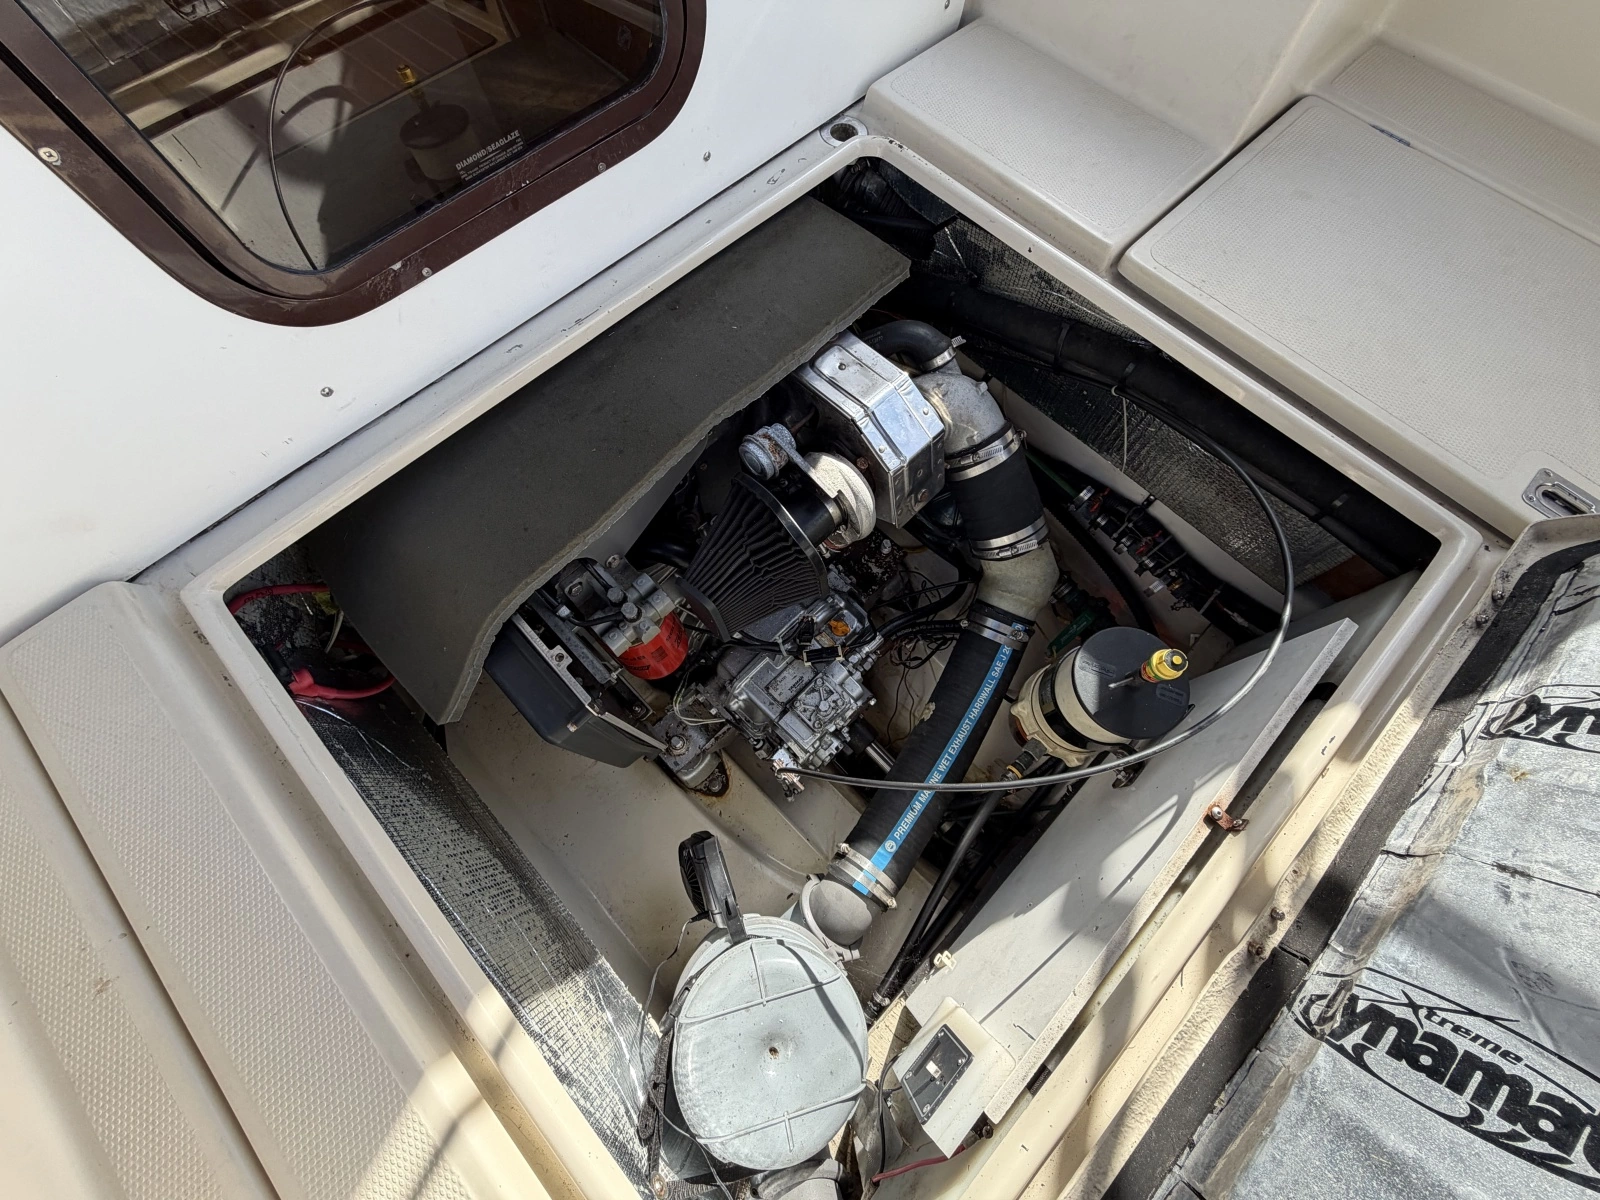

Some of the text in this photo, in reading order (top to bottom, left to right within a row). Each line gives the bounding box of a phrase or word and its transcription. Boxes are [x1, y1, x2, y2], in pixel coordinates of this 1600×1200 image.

[455, 129, 520, 171] DIAMOND/SEAGLAZE
[893, 799, 923, 841] PREMIUM
[937, 754, 953, 772] WET
[948, 718, 973, 756] EXHAUST
[969, 679, 996, 721] HARDWALL
[991, 660, 1004, 678] SAE
[1400, 989, 1524, 1066] Xtreme
